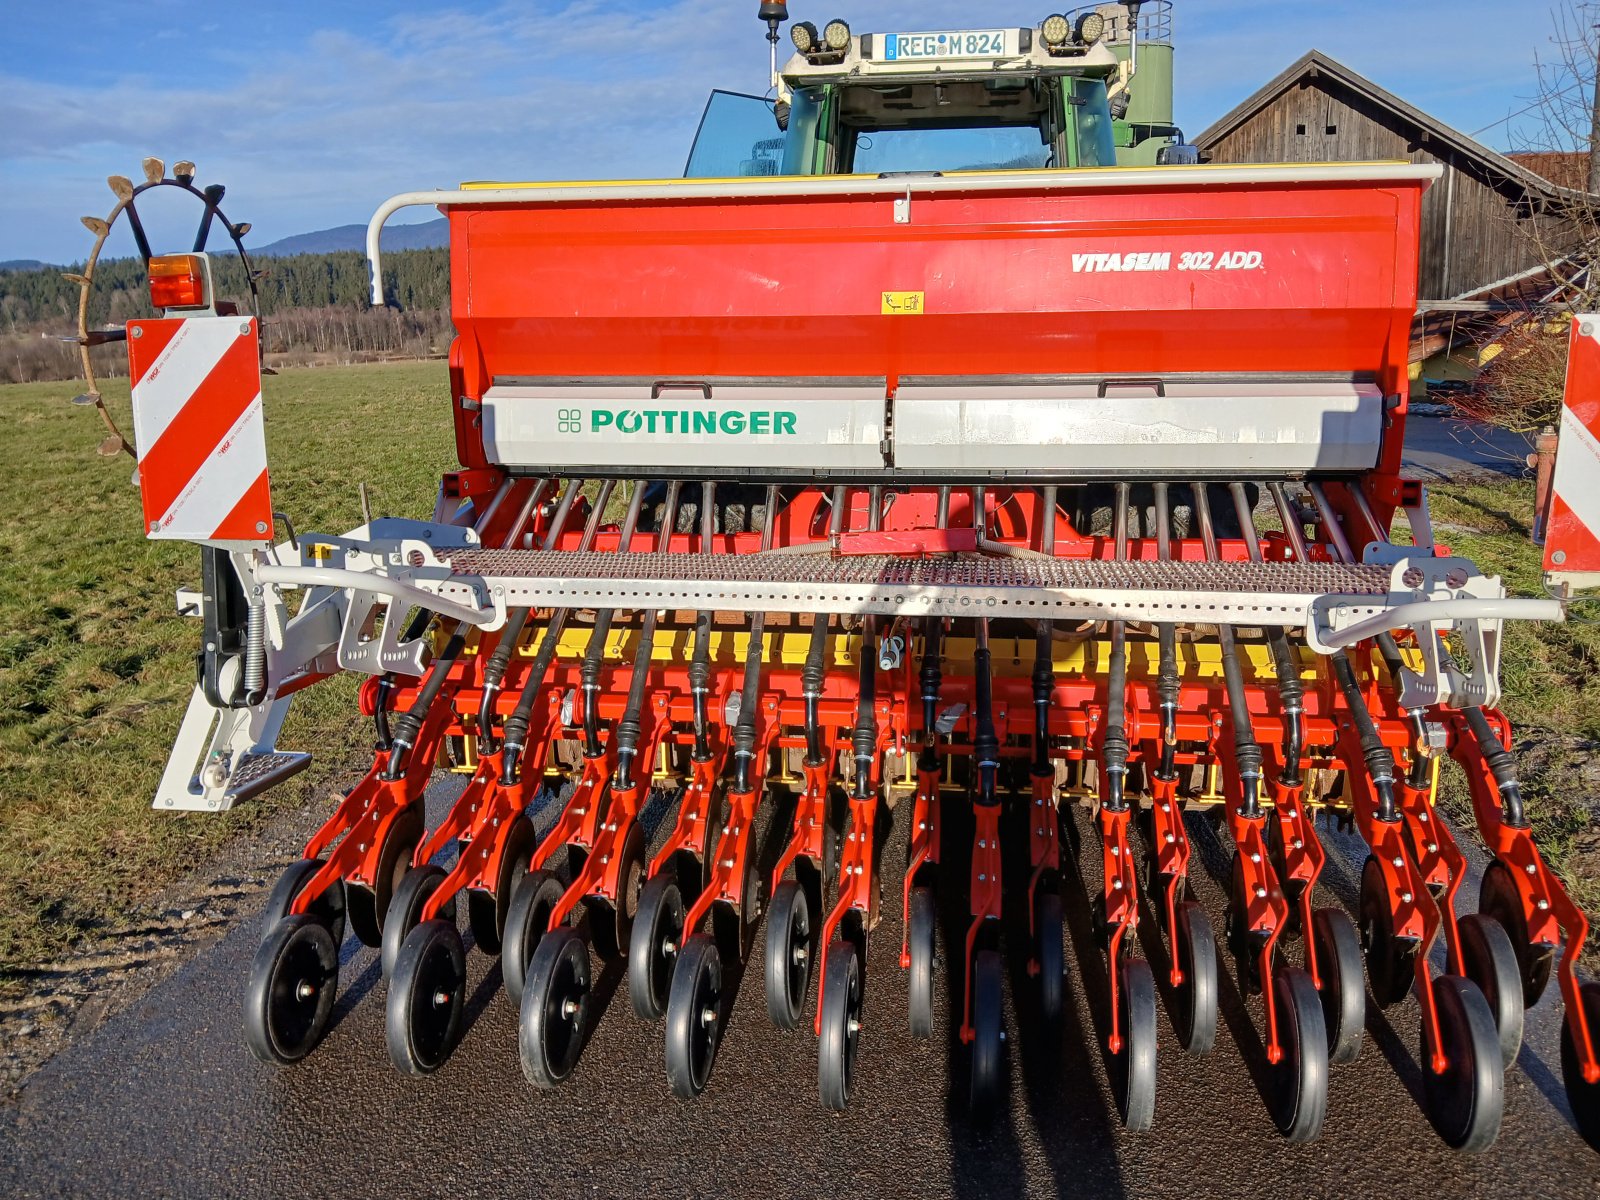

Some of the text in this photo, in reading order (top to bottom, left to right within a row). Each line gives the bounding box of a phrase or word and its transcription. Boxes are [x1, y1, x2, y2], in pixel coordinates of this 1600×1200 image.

[898, 36, 936, 57] REG
[950, 35, 962, 54] M
[966, 33, 1002, 54] 824
[1071, 251, 1263, 272] VITASEM 302 ADD
